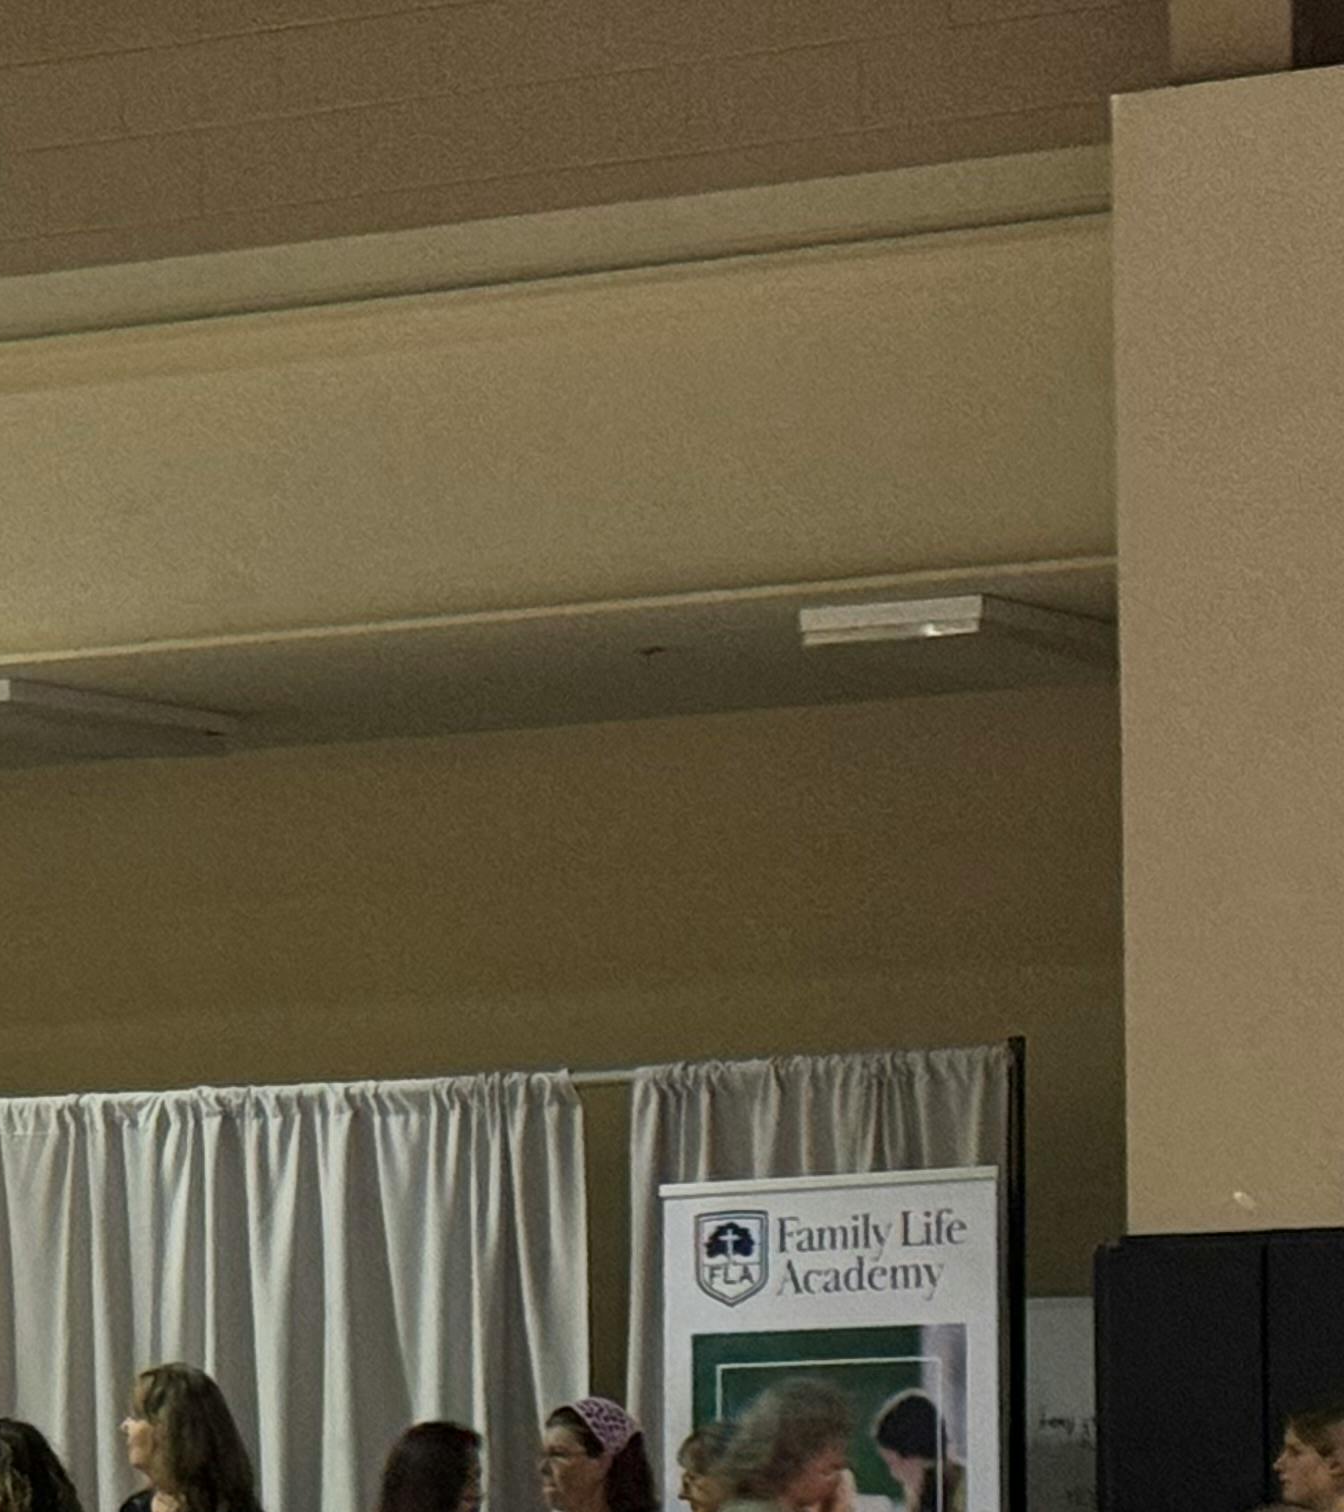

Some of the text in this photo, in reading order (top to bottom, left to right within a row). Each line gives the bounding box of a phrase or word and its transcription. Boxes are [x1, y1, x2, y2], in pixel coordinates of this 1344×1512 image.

[777, 1208, 968, 1262] Family Life
[709, 1265, 755, 1286] FLA
[775, 1256, 945, 1301] Academy
